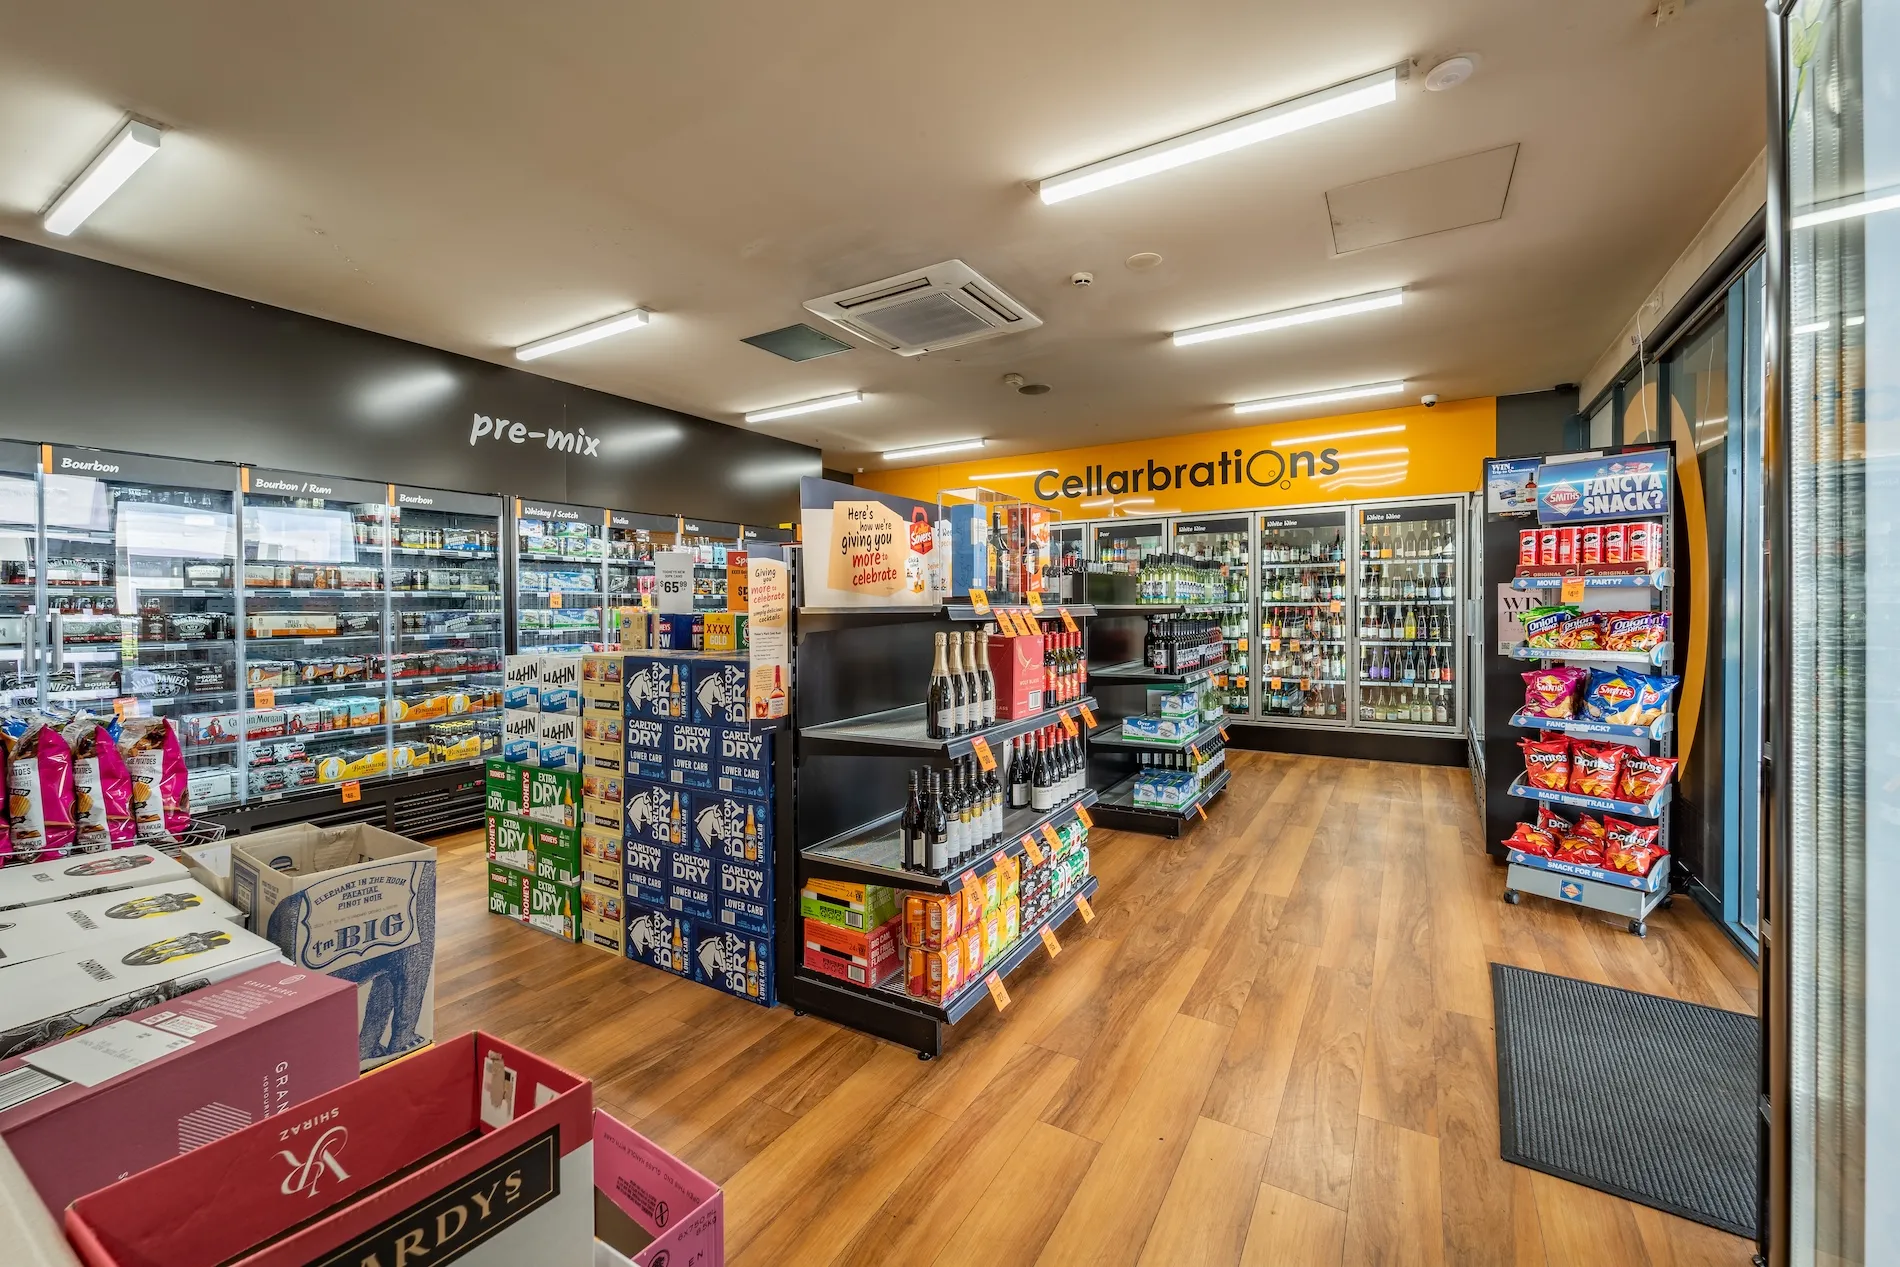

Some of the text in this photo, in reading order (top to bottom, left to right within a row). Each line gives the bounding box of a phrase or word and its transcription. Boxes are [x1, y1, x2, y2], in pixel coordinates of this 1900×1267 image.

[470, 413, 600, 457] pre-mix
[62, 457, 119, 475] Bourbon
[1033, 447, 1339, 501] Cellarbrations
[255, 478, 332, 494] Bourbon / Rum
[1583, 472, 1663, 496] FANCY A
[399, 493, 433, 506] Bourbon
[1582, 490, 1663, 515] SNACK?
[525, 507, 551, 518] Whiskey
[557, 510, 579, 519] Scotch
[613, 516, 629, 525] Vodka
[848, 505, 874, 520] Here's
[685, 524, 699, 532] Vodka
[860, 519, 892, 532] how we're
[842, 531, 892, 555] giving you
[910, 531, 932, 546] Savers
[852, 552, 888, 568] more to
[755, 568, 776, 579] Giving
[852, 566, 897, 586] celebrate
[751, 585, 770, 595] more
[1536, 579, 1561, 587] MOVIE
[754, 592, 785, 603] celebrate
[759, 614, 781, 623] cocktails
[1528, 615, 1558, 631] Onion
[1563, 615, 1594, 632] Onion
[706, 623, 731, 635] XXXX
[709, 635, 728, 646] GOLD
[131, 674, 190, 692] JACK DANIEL'S
[652, 661, 660, 716] CARLTON
[725, 665, 733, 722] CARLTON
[629, 719, 663, 731] CARLTON
[673, 724, 711, 738] CARLTON
[673, 758, 709, 772] LOWER CARB
[1530, 753, 1568, 764] Doritos
[1574, 755, 1615, 771] Doritos
[1627, 759, 1663, 775] oritos
[538, 772, 557, 785] EXTRA
[721, 765, 760, 780] LOWER CARB
[522, 771, 530, 815] TOOHEYS
[532, 781, 563, 806] DRY
[1538, 791, 1560, 801] MADE
[488, 796, 505, 812] DRY
[652, 785, 660, 840] CARLTON
[502, 818, 521, 830] EXTRA
[724, 798, 732, 856] CARLTON
[488, 817, 496, 859] TOOHEYS
[498, 826, 526, 851] DRY
[627, 840, 661, 857] CARLTON
[672, 851, 710, 869] CARLTON
[538, 863, 557, 881] DRY
[721, 863, 763, 882] CARLTON
[1547, 861, 1605, 880] SNACK FOR ME
[314, 876, 407, 906] ELEPHANT IN THE ROOM
[342, 886, 379, 901] PALATIAL
[537, 880, 557, 895] EXTRA
[672, 884, 708, 903] LOWER CARB
[338, 893, 383, 911] PINOT NOIR
[490, 898, 507, 914] DRY
[522, 879, 530, 921] TOOHEYS
[532, 889, 563, 915] DRY
[724, 897, 764, 917] LOWER CARB
[312, 938, 335, 958] I'm
[333, 912, 405, 952] BIG
[653, 910, 662, 965] CARLTON
[725, 931, 734, 990] CARLTON
[275, 1060, 289, 1114] GRAN
[278, 1107, 340, 1142] SHIRAZ
[626, 1148, 645, 1166] HANDLE
[646, 1161, 661, 1176] GLASS
[663, 1173, 674, 1185] END
